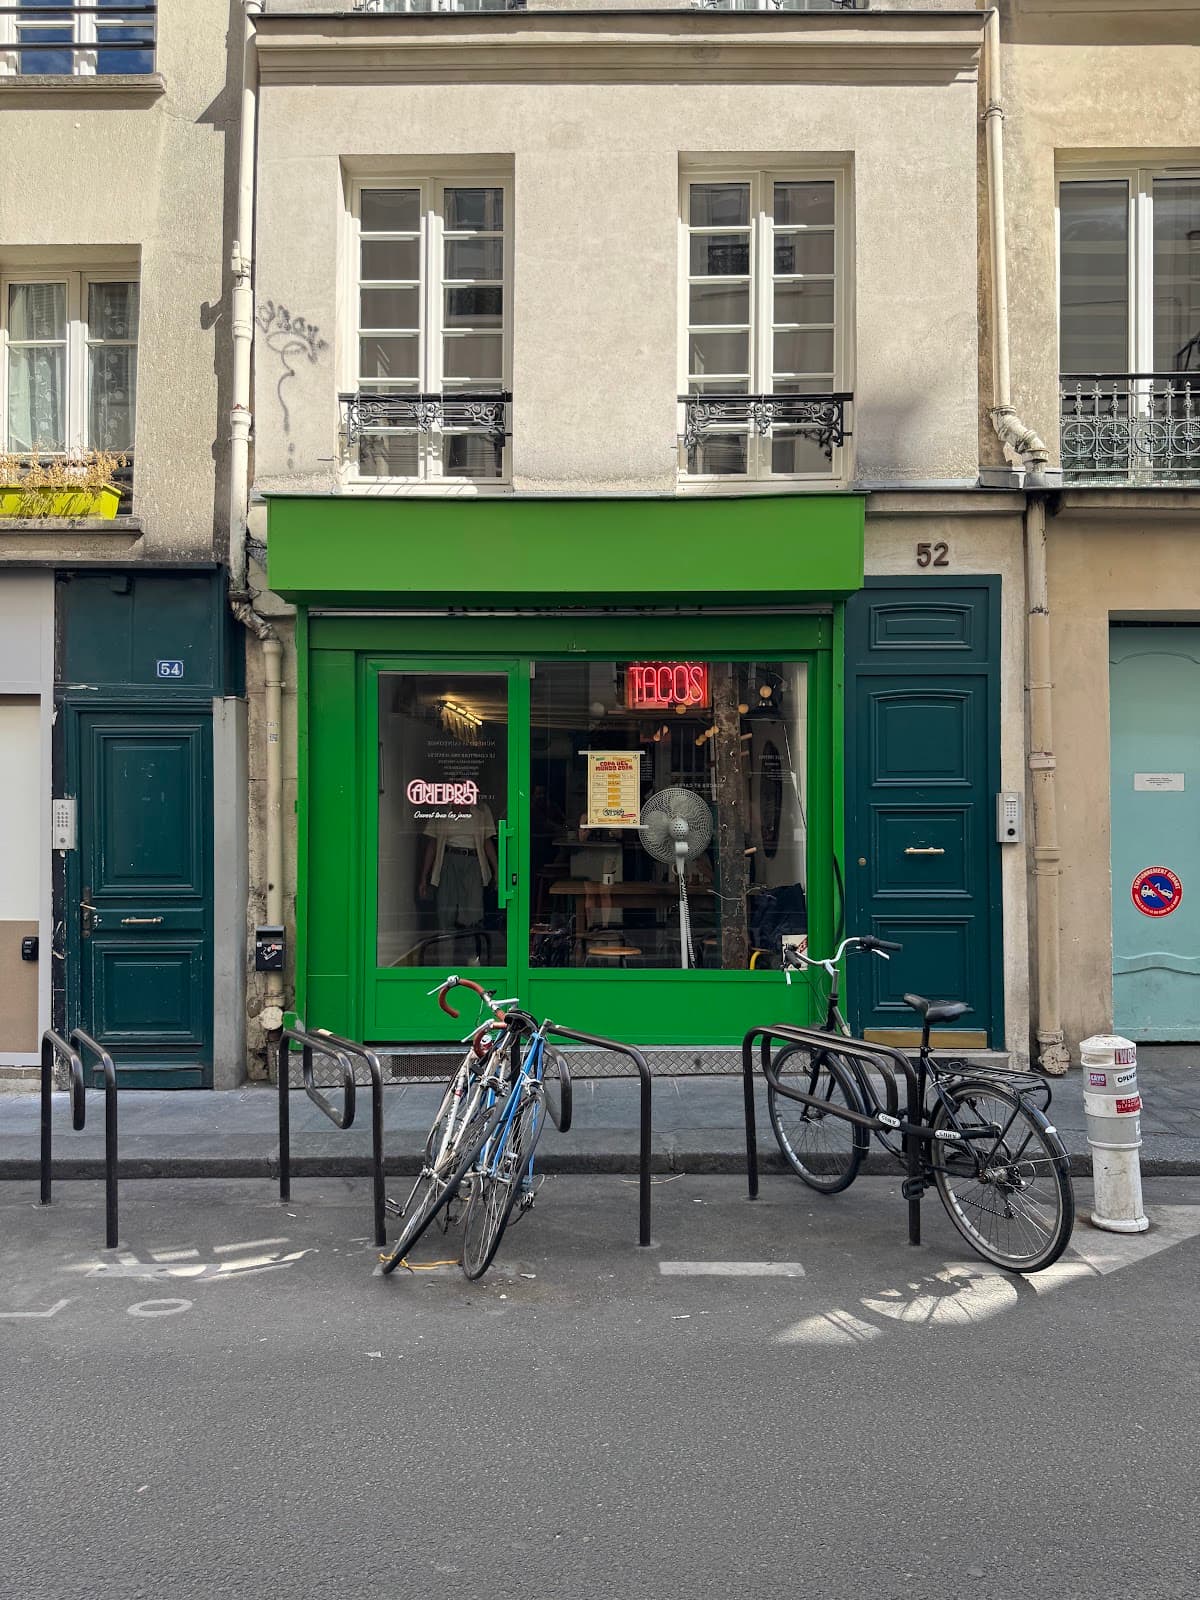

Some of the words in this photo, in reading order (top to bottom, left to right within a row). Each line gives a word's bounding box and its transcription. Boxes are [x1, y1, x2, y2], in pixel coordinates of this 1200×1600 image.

[917, 542, 949, 567] 52
[161, 663, 180, 675] 54
[629, 666, 703, 702] TACOS
[413, 810, 435, 819] Ouvert
[1133, 867, 1168, 889] STATIONNEMENT
